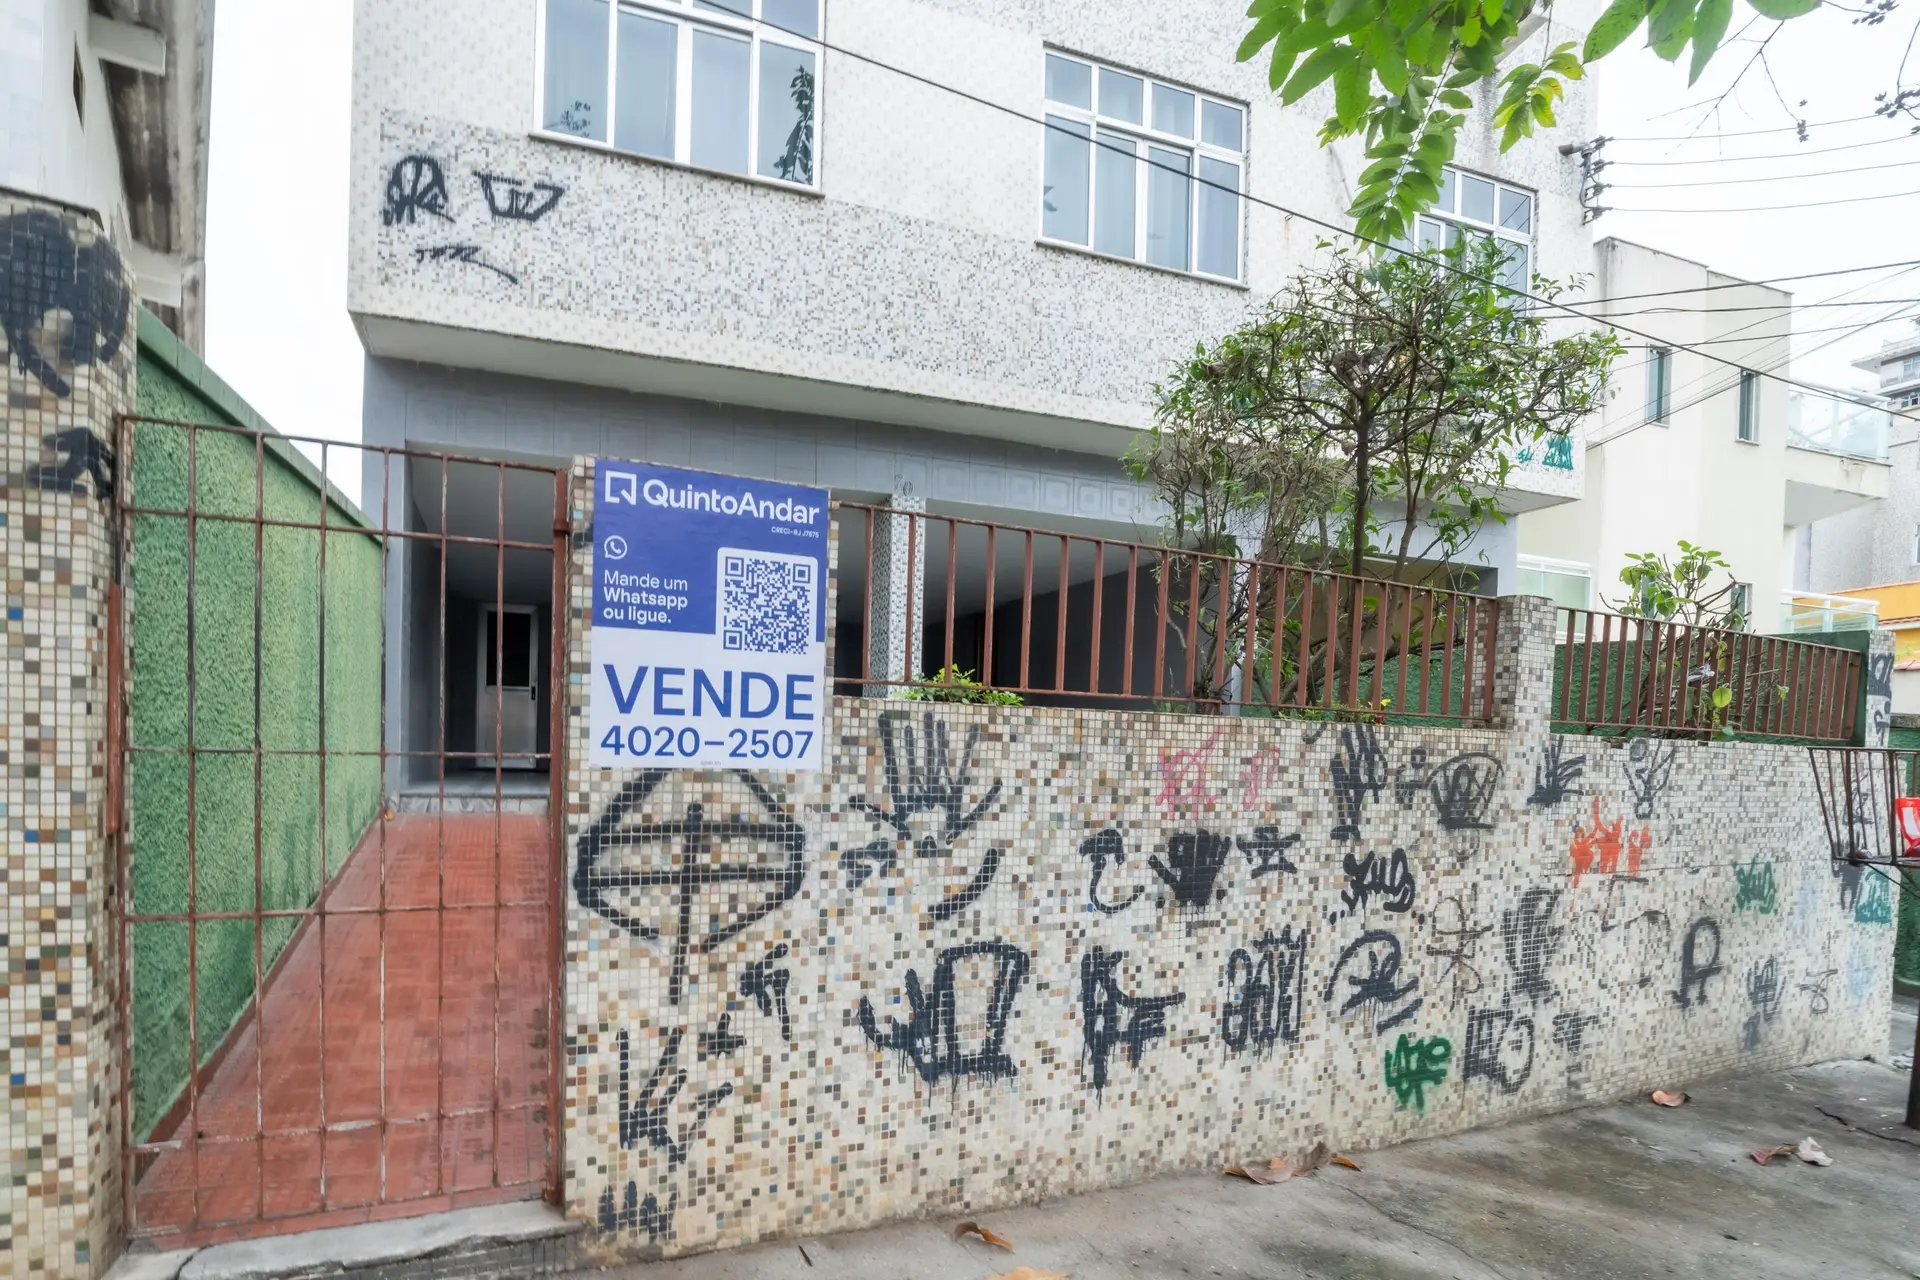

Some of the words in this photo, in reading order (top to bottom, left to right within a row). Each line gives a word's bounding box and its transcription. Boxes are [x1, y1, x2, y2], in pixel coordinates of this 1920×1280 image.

[643, 479, 820, 525] QuintoAndar
[604, 569, 660, 588] Mande
[664, 578, 688, 591] um
[603, 586, 688, 610] Whatsapp
[603, 607, 624, 620] ou
[628, 606, 672, 625] ligue.
[603, 664, 815, 721] VENDE
[600, 725, 814, 759] 4020-2507
